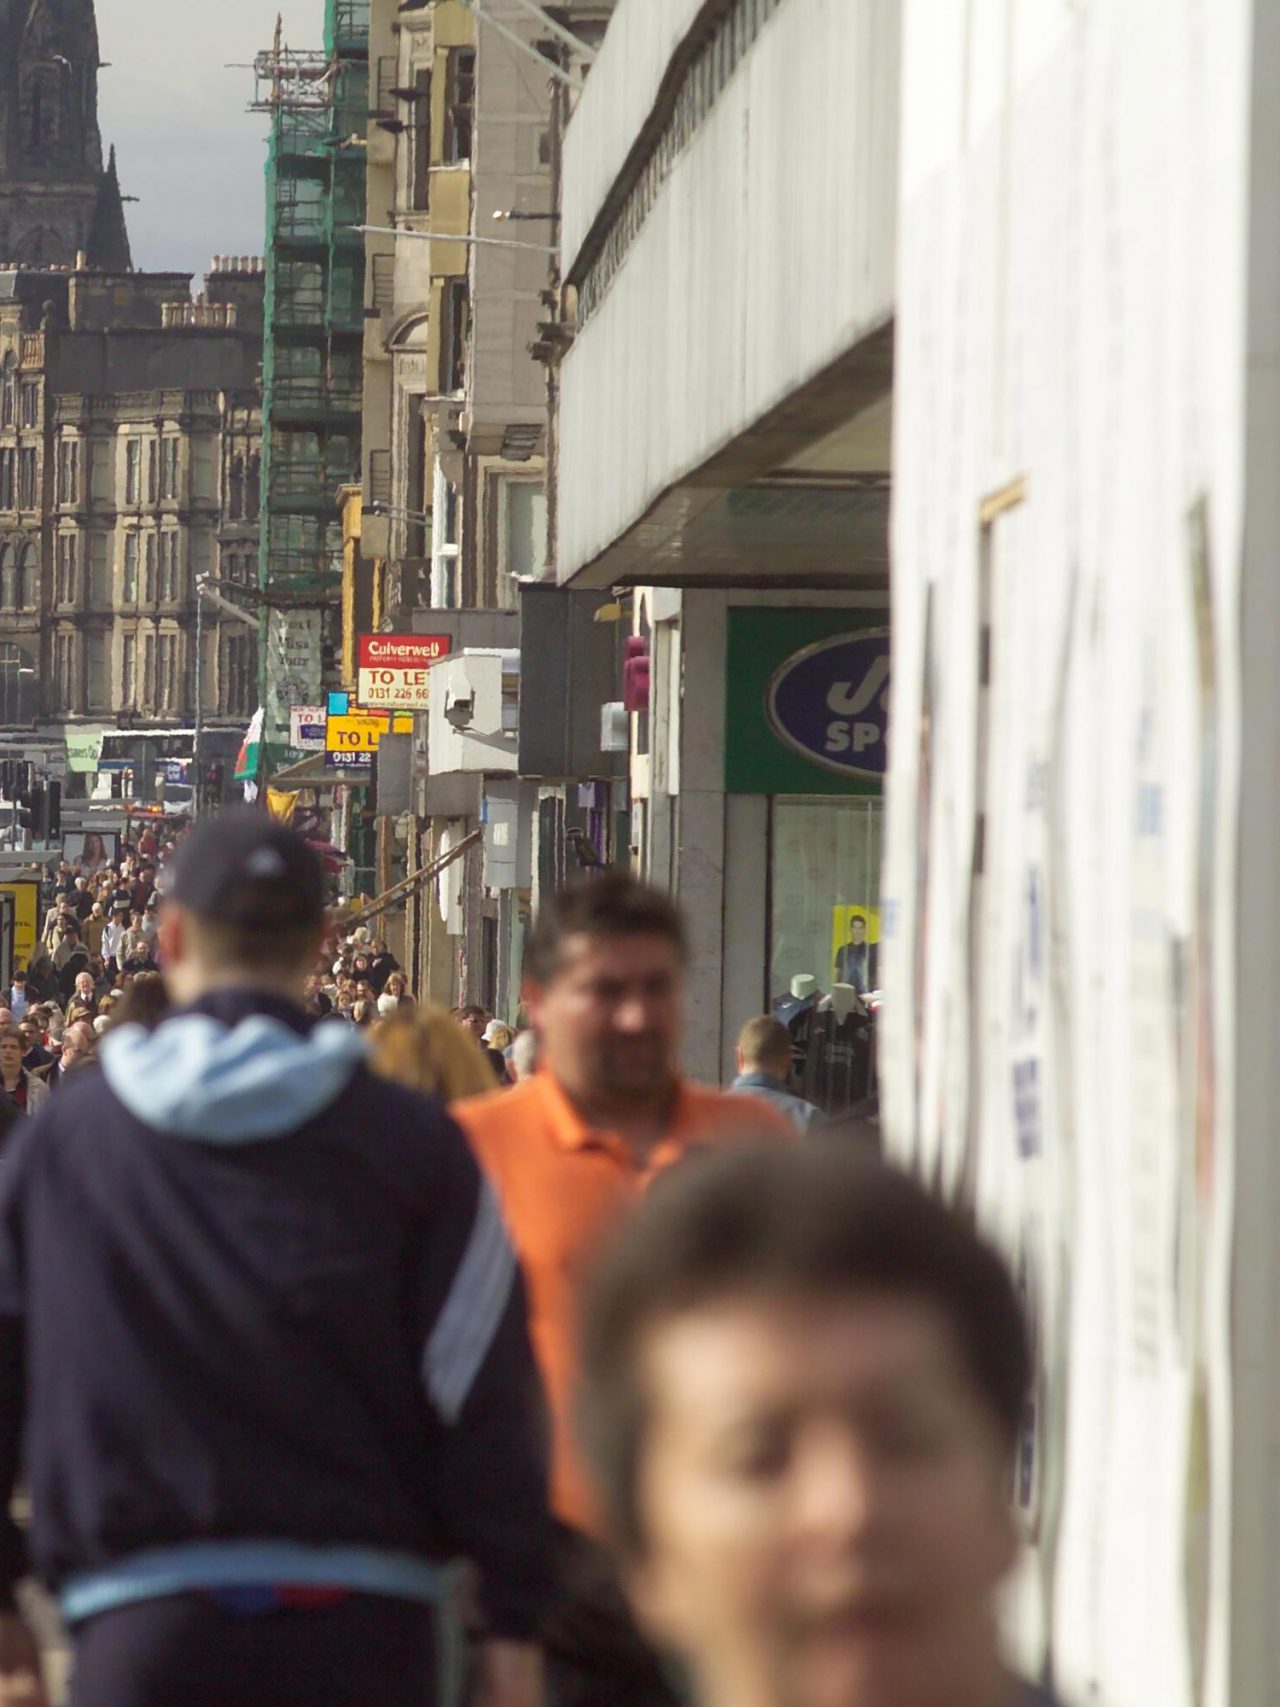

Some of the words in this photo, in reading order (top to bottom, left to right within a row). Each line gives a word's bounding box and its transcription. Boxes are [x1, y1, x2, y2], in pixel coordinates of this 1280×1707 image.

[368, 641, 440, 657] Culverwell
[369, 670, 394, 685] TO
[368, 687, 391, 699] 0131
[337, 731, 361, 745] TO
[824, 720, 888, 752] SP
[332, 751, 356, 763] 0131
